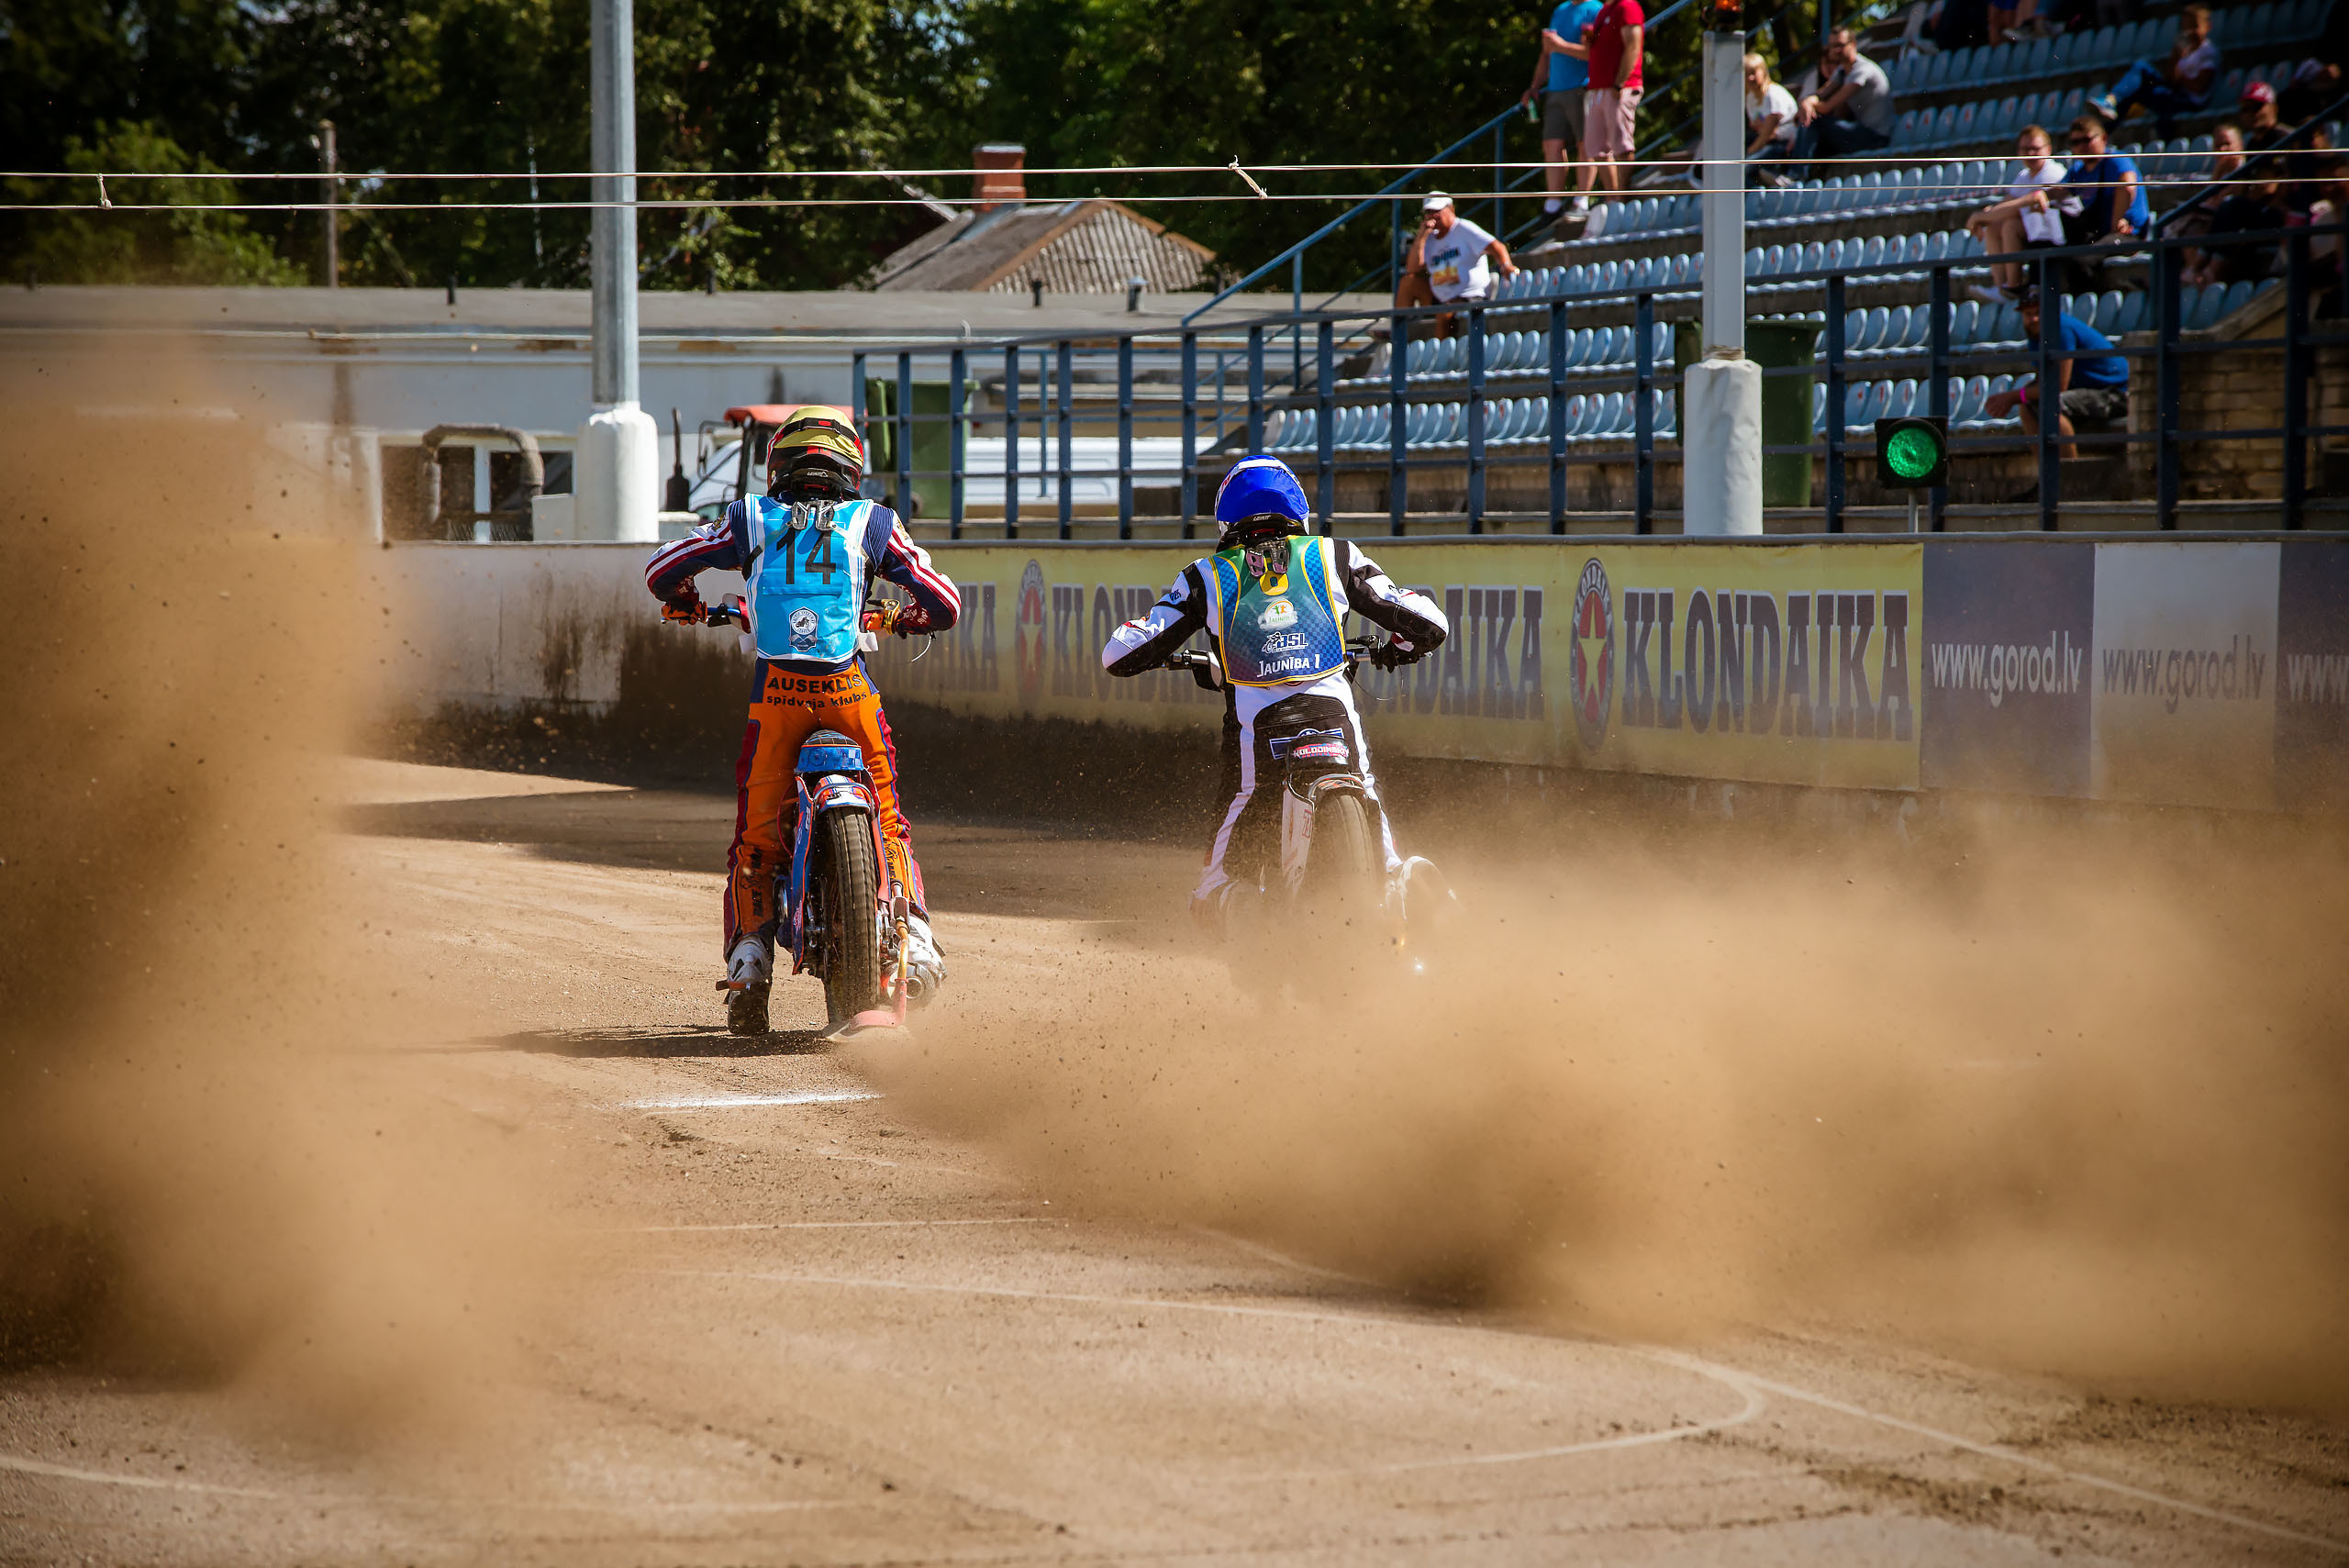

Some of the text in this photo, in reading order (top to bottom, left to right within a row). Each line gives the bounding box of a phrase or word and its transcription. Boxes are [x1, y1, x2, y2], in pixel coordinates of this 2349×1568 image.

[776, 528, 836, 584] 14
[767, 674, 863, 695] AUSEKLIS
[1257, 656, 1310, 677] JAUNĪBA
[1622, 586, 1914, 741] KLONDAIKA
[1932, 630, 2083, 707] www.gorod.lv
[2102, 635, 2266, 714] www.gorod.lv
[829, 692, 867, 707] klubs
